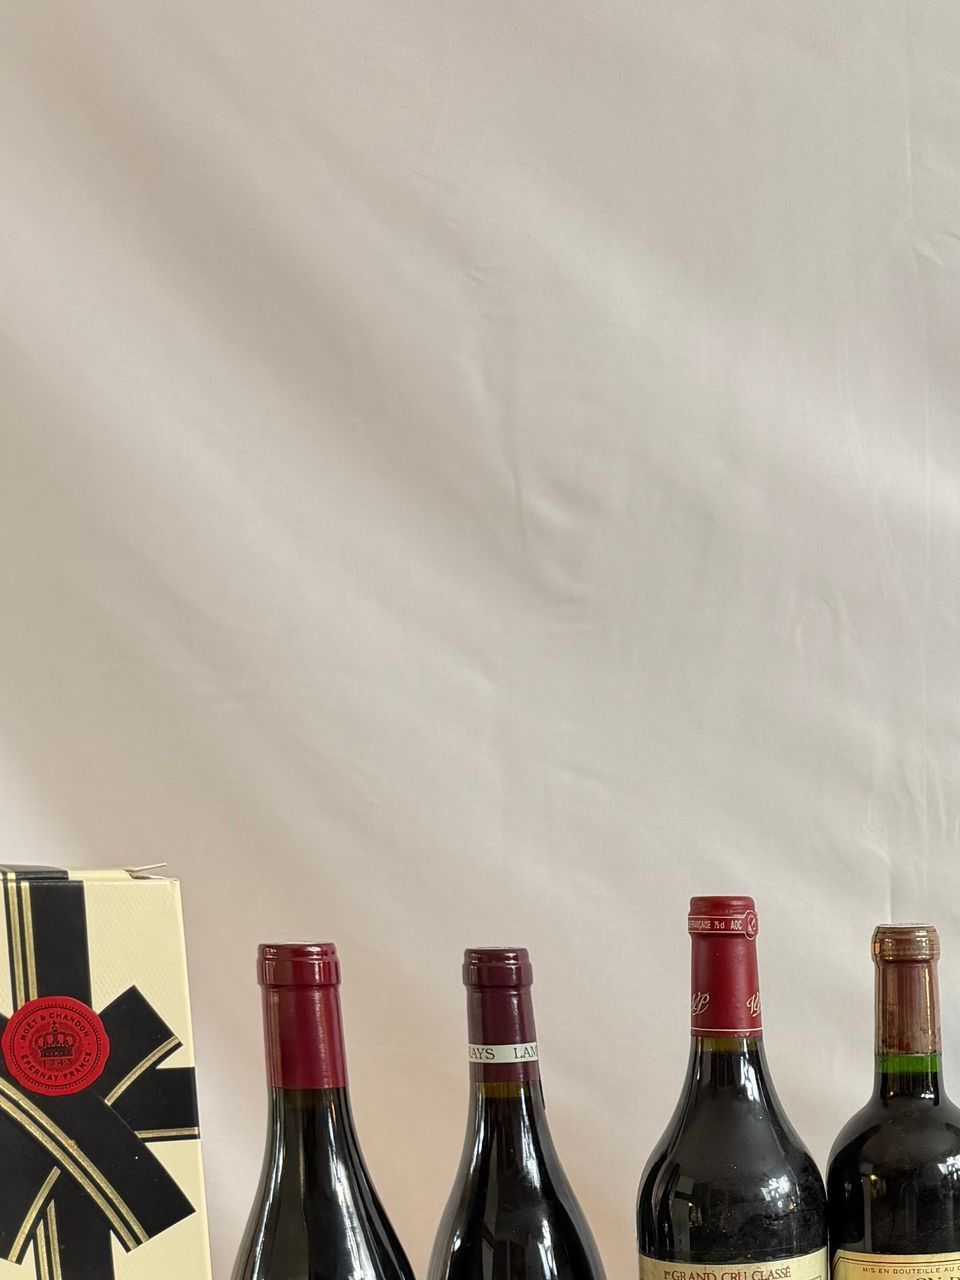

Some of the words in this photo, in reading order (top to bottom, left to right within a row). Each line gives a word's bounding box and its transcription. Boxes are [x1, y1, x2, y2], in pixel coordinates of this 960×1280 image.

[731, 920, 742, 930] AOC
[48, 1012, 90, 1038] CHANDON
[63, 1051, 92, 1079] FRANCE
[892, 1267, 941, 1275] BOUTEILLE
[944, 1265, 955, 1273] AU
